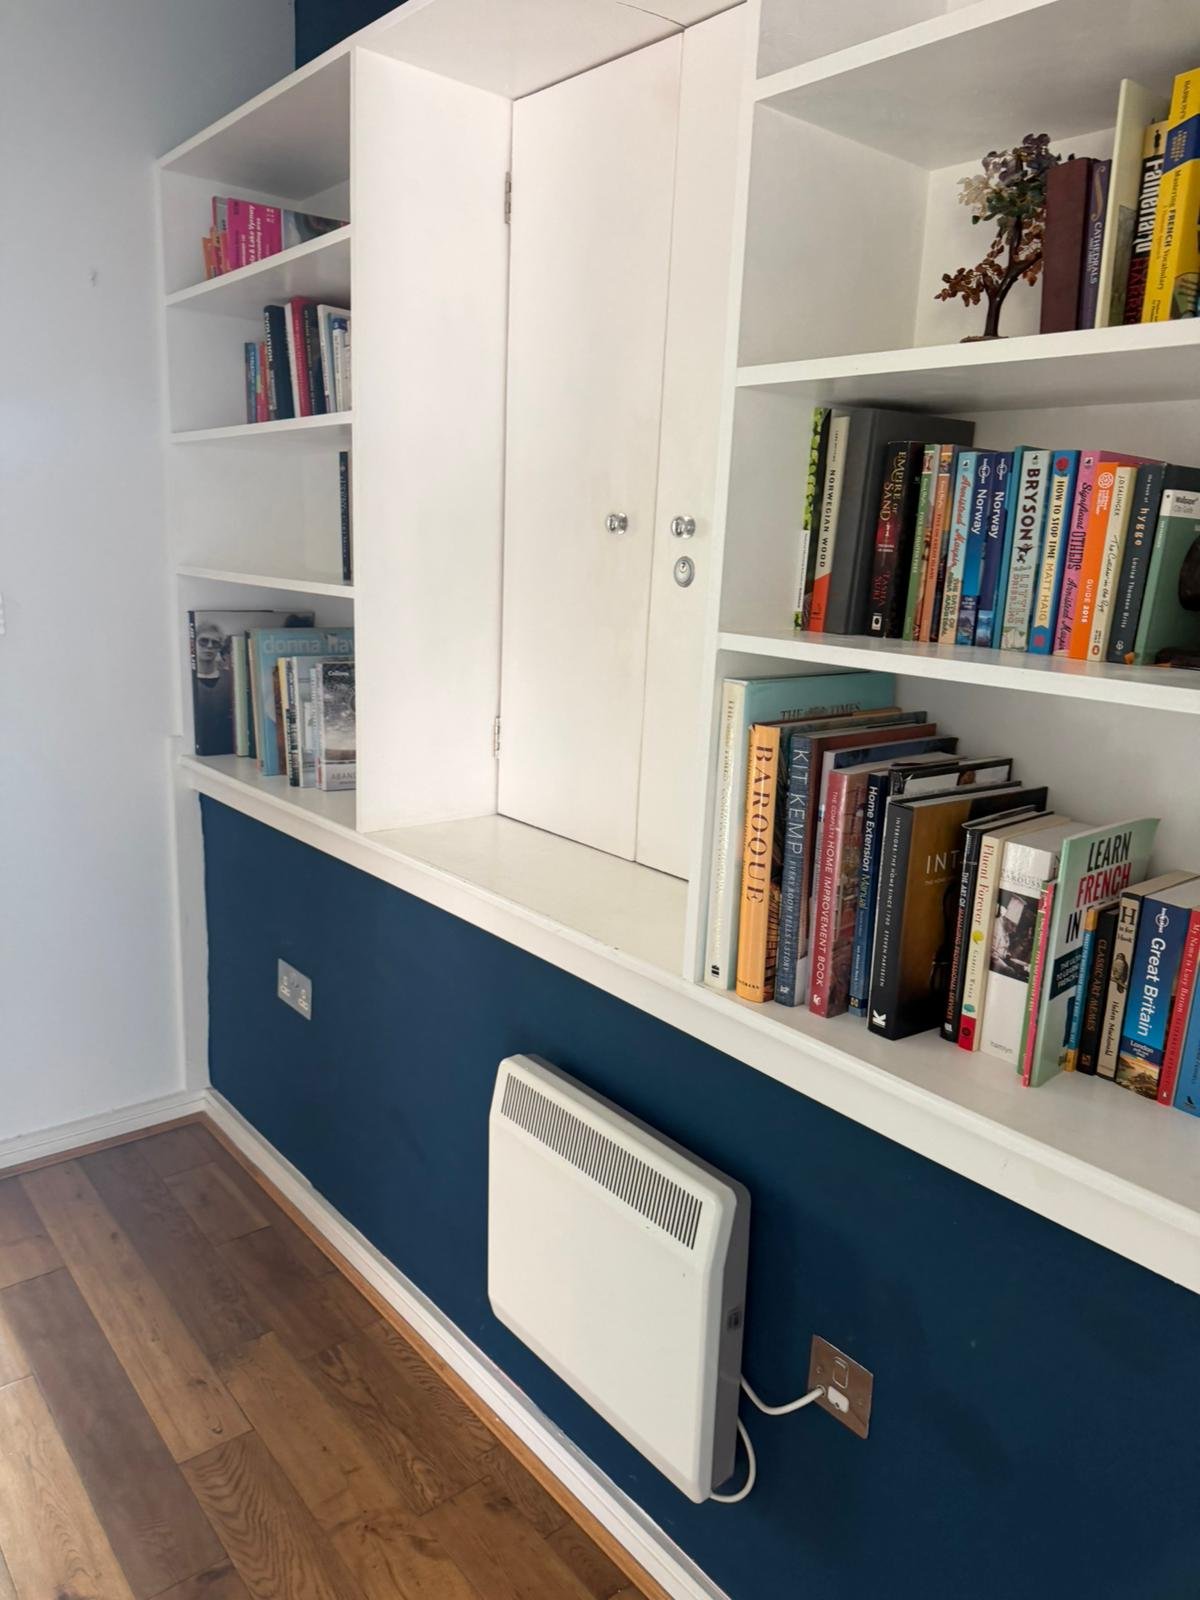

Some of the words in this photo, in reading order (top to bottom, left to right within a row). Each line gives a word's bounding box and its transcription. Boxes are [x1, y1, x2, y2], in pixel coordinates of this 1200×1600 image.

[1164, 208, 1175, 247] FRENCH
[1090, 221, 1103, 284] CATHEDRALS
[892, 450, 906, 499] EMPIRE
[1054, 480, 1067, 501] HOW
[824, 469, 837, 533] NORWEGIAN
[879, 482, 893, 521] SAND
[971, 488, 987, 534] Norway
[989, 491, 1004, 538] Norway
[1020, 467, 1040, 541] BRYSON
[1053, 503, 1063, 515] TO
[1078, 481, 1092, 530] Significant
[1049, 516, 1061, 537] STOP
[1134, 506, 1150, 546] hygge
[818, 537, 828, 568] WOOD
[1046, 540, 1058, 559] TIME
[1067, 530, 1086, 570] OTHERS
[1043, 562, 1053, 592] MATT
[1083, 578, 1093, 603] GUIDE
[1038, 594, 1049, 621] HAIG
[1063, 577, 1077, 619] Armistead
[263, 635, 321, 654] donna
[791, 749, 809, 780] KIT
[866, 785, 878, 818] Home
[747, 745, 772, 903] BAROQUE
[787, 793, 806, 853] KEMP
[828, 805, 836, 838] COMPLETE
[824, 840, 835, 872] HOME
[862, 820, 874, 871] Extension
[982, 843, 994, 880] Fluent
[1087, 831, 1132, 872] LEARN
[787, 860, 796, 885] EVERY
[1076, 863, 1132, 908] FRENCH
[785, 887, 794, 911] ROOM
[859, 873, 870, 908] Manual
[959, 884, 967, 896] ART
[959, 897, 965, 907] OF
[975, 883, 988, 925] Forever
[783, 914, 792, 937] TELLS
[817, 875, 832, 953] IMPROVEMENT
[1066, 909, 1083, 944] IN
[1121, 905, 1137, 926] H
[1190, 923, 1199, 935] My
[781, 944, 790, 971] STORY
[1093, 938, 1106, 977] CLASSIC
[1149, 936, 1166, 982] Great
[1187, 936, 1196, 957] Name
[815, 955, 826, 985] BOOK
[1091, 978, 1101, 996] ART
[1181, 968, 1191, 985] Lucy
[1086, 997, 1098, 1031] MEMES
[1108, 1000, 1119, 1020] Helen
[1137, 984, 1158, 1037] Britain
[1104, 1022, 1115, 1056] Macdonald
